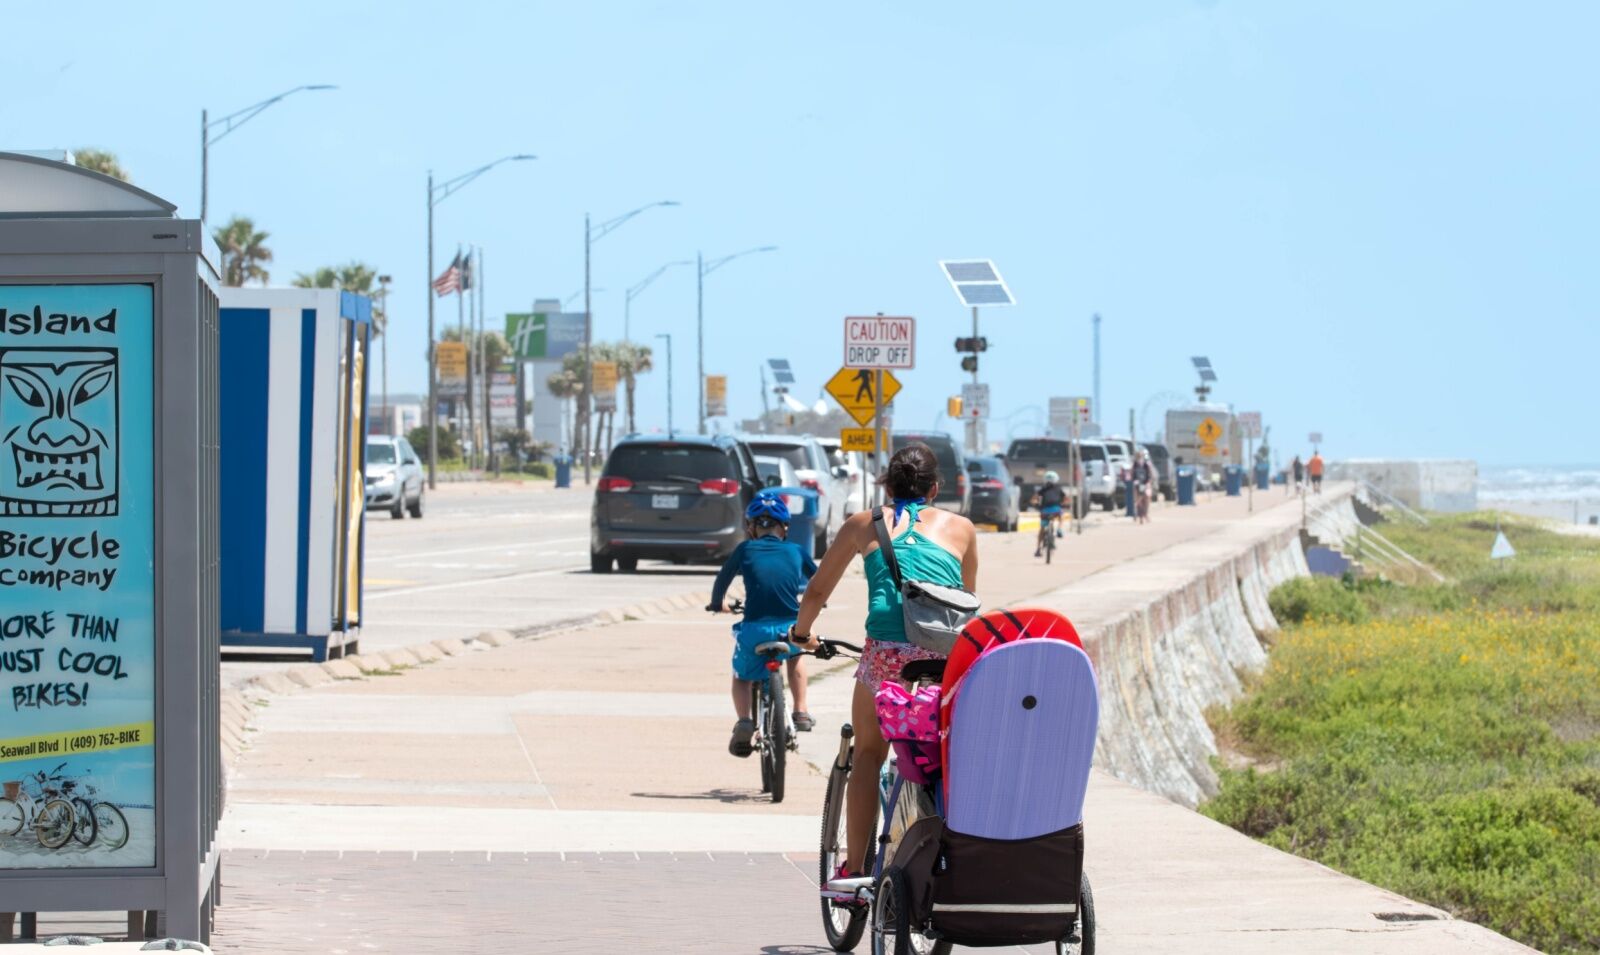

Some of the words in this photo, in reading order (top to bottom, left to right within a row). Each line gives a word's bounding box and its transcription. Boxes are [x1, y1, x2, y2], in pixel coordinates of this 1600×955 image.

[0, 304, 117, 336] Island
[850, 322, 908, 341] CAUTION
[849, 346, 880, 363] DROP
[887, 346, 909, 363] OFF
[846, 433, 874, 445] AHEA
[0, 529, 121, 566] Bicycle
[67, 613, 120, 643] THAN
[58, 647, 128, 681] COOL
[13, 682, 89, 712] BIKES!
[0, 741, 36, 758] Seawall
[38, 740, 59, 754] Blvd
[70, 735, 97, 751] (409)
[98, 729, 140, 746] 762-BIKE
